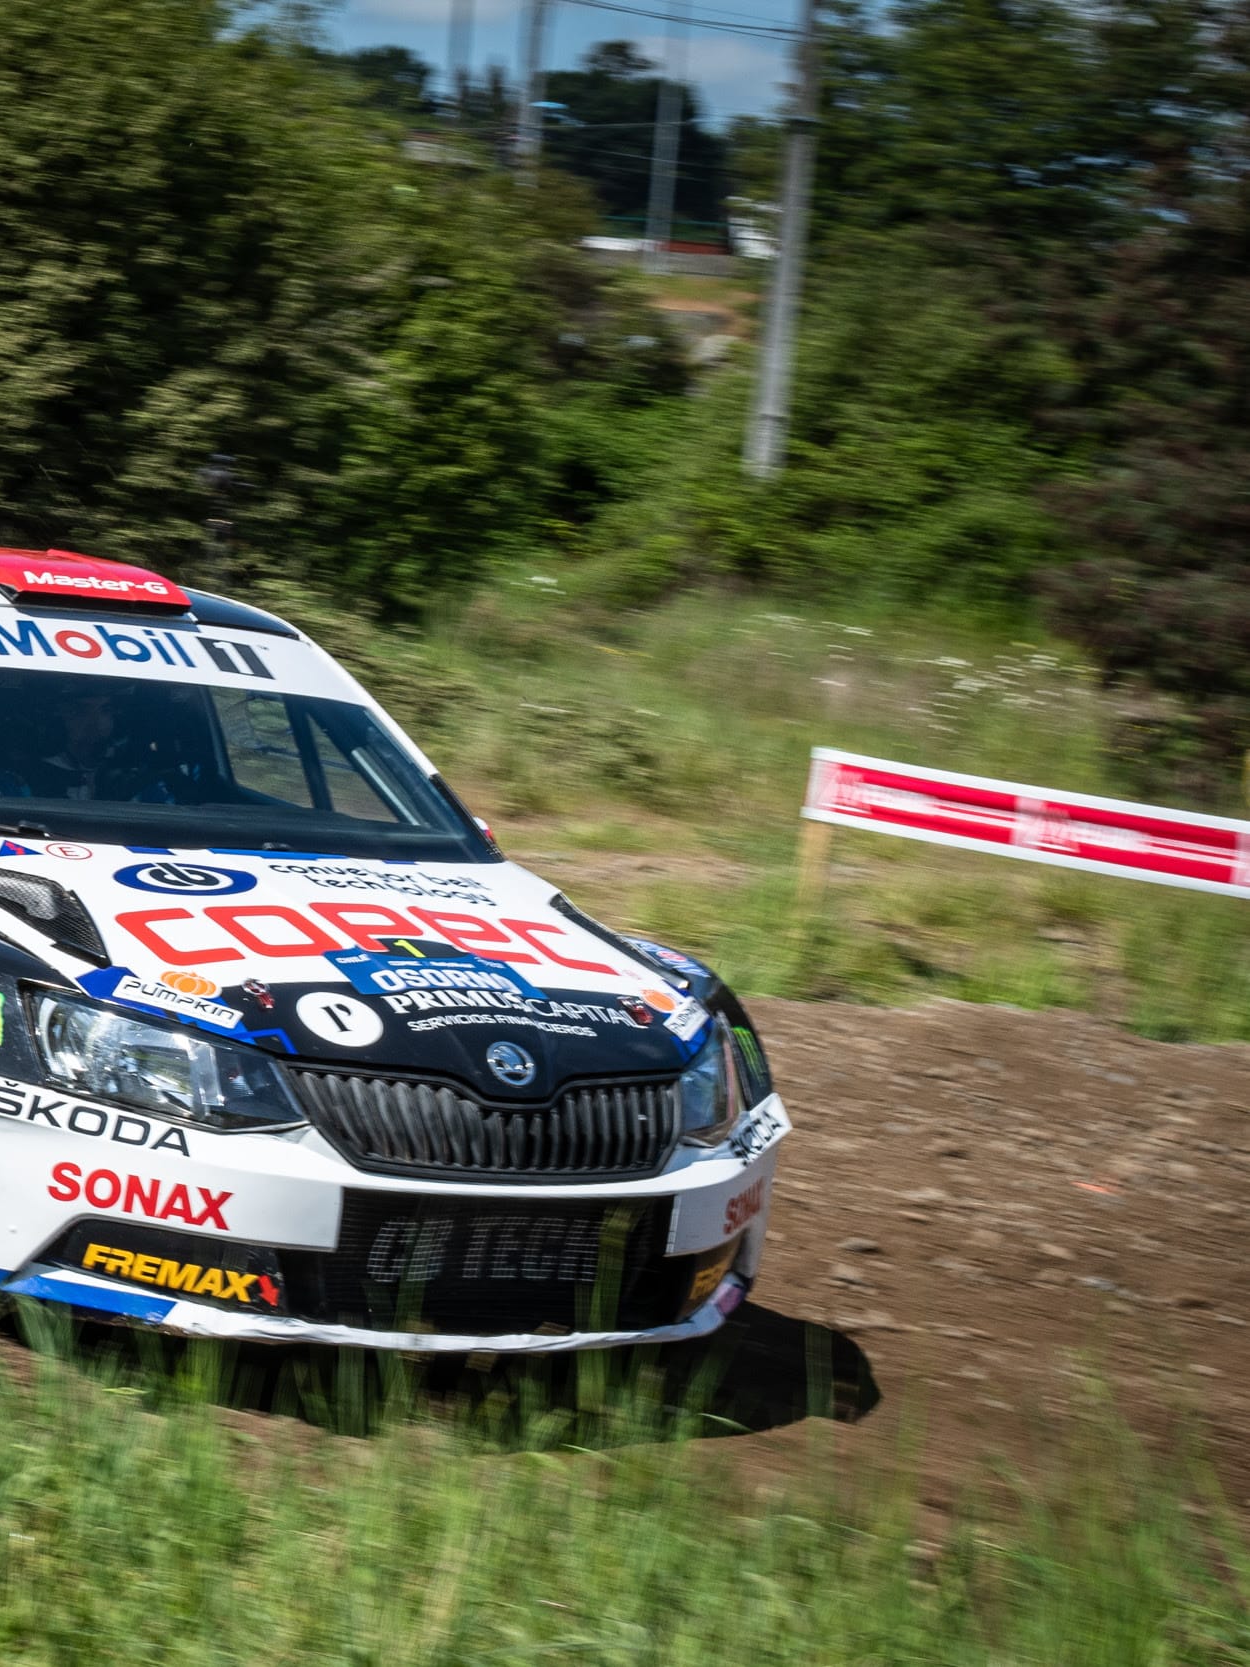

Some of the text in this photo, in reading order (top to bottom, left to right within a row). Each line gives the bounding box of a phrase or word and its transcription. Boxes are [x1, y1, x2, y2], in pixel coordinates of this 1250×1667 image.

[23, 570, 169, 595] Master-G
[203, 638, 266, 677] 1
[393, 939, 427, 958] 1
[370, 969, 522, 995] OSORNO
[381, 989, 532, 1014] PRIMUS
[525, 998, 648, 1029] CAPITAL
[407, 1013, 496, 1032] SERVICIOS
[47, 1162, 235, 1231] SONAX
[82, 1243, 260, 1303] FREMAX
